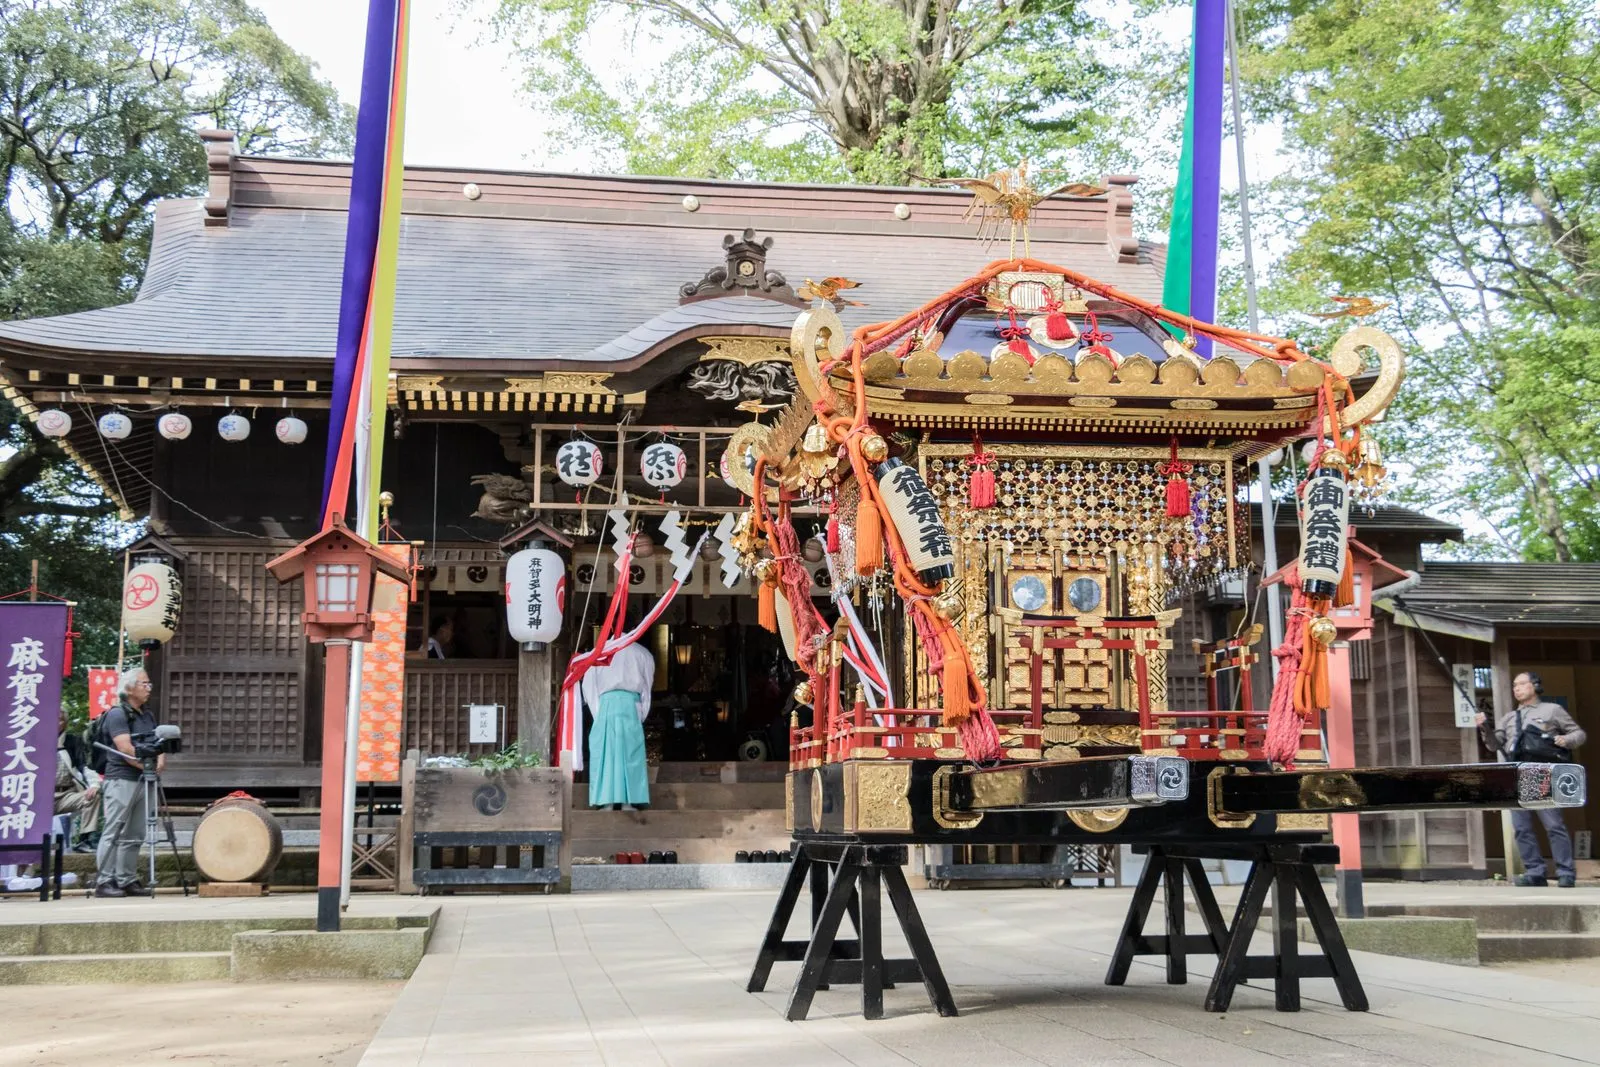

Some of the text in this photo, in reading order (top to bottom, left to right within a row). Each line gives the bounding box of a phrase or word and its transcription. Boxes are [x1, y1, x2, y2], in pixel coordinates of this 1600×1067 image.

[527, 557, 542, 630] 麻賀多大明神
[0, 637, 49, 839] 麻賀多大明神
